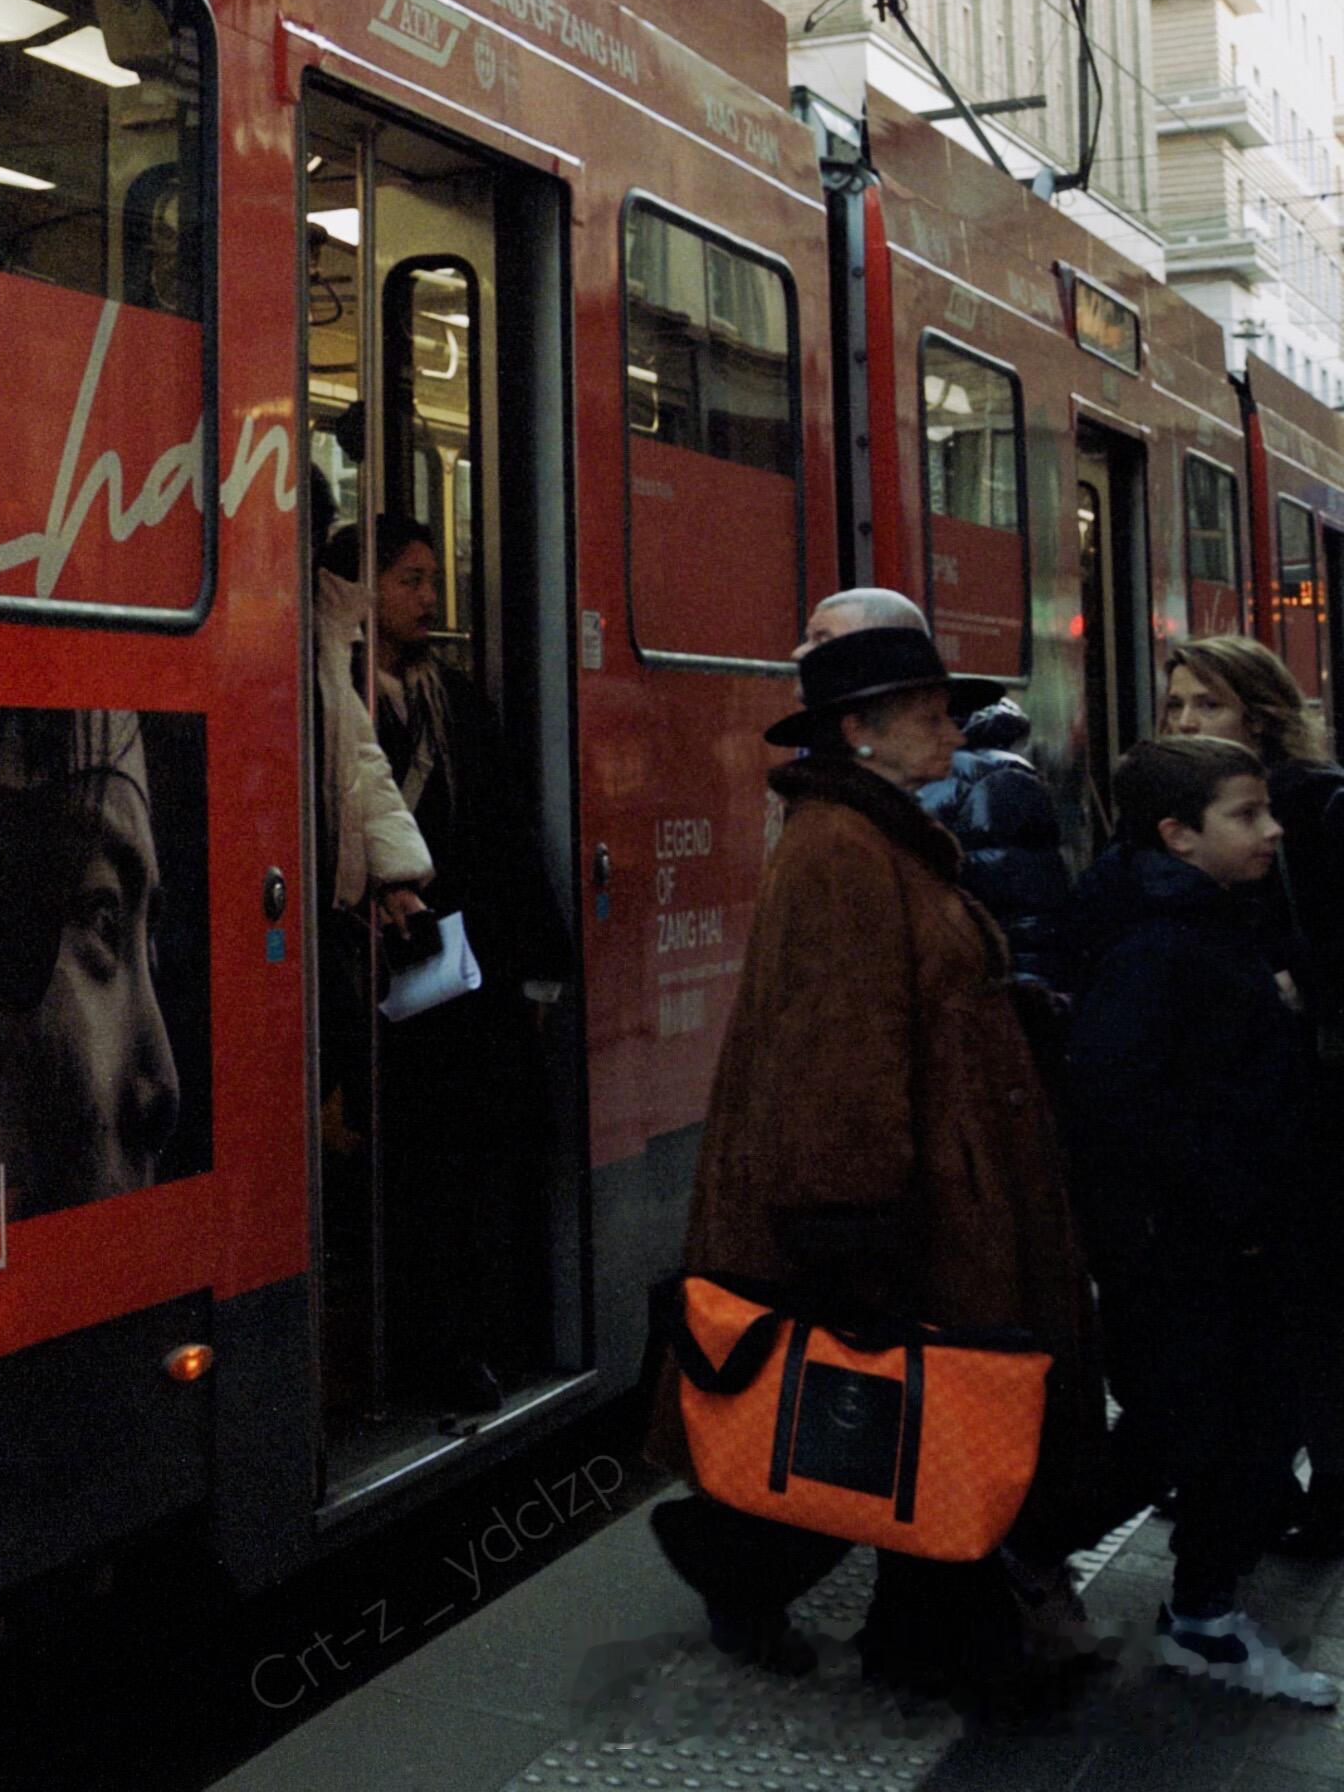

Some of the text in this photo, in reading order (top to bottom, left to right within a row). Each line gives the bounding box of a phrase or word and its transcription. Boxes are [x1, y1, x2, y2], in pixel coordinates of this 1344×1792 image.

[558, 7, 608, 67] ZANG
[609, 41, 639, 85] HAI
[656, 818, 711, 860] LEGEND
[656, 866, 676, 906] OF
